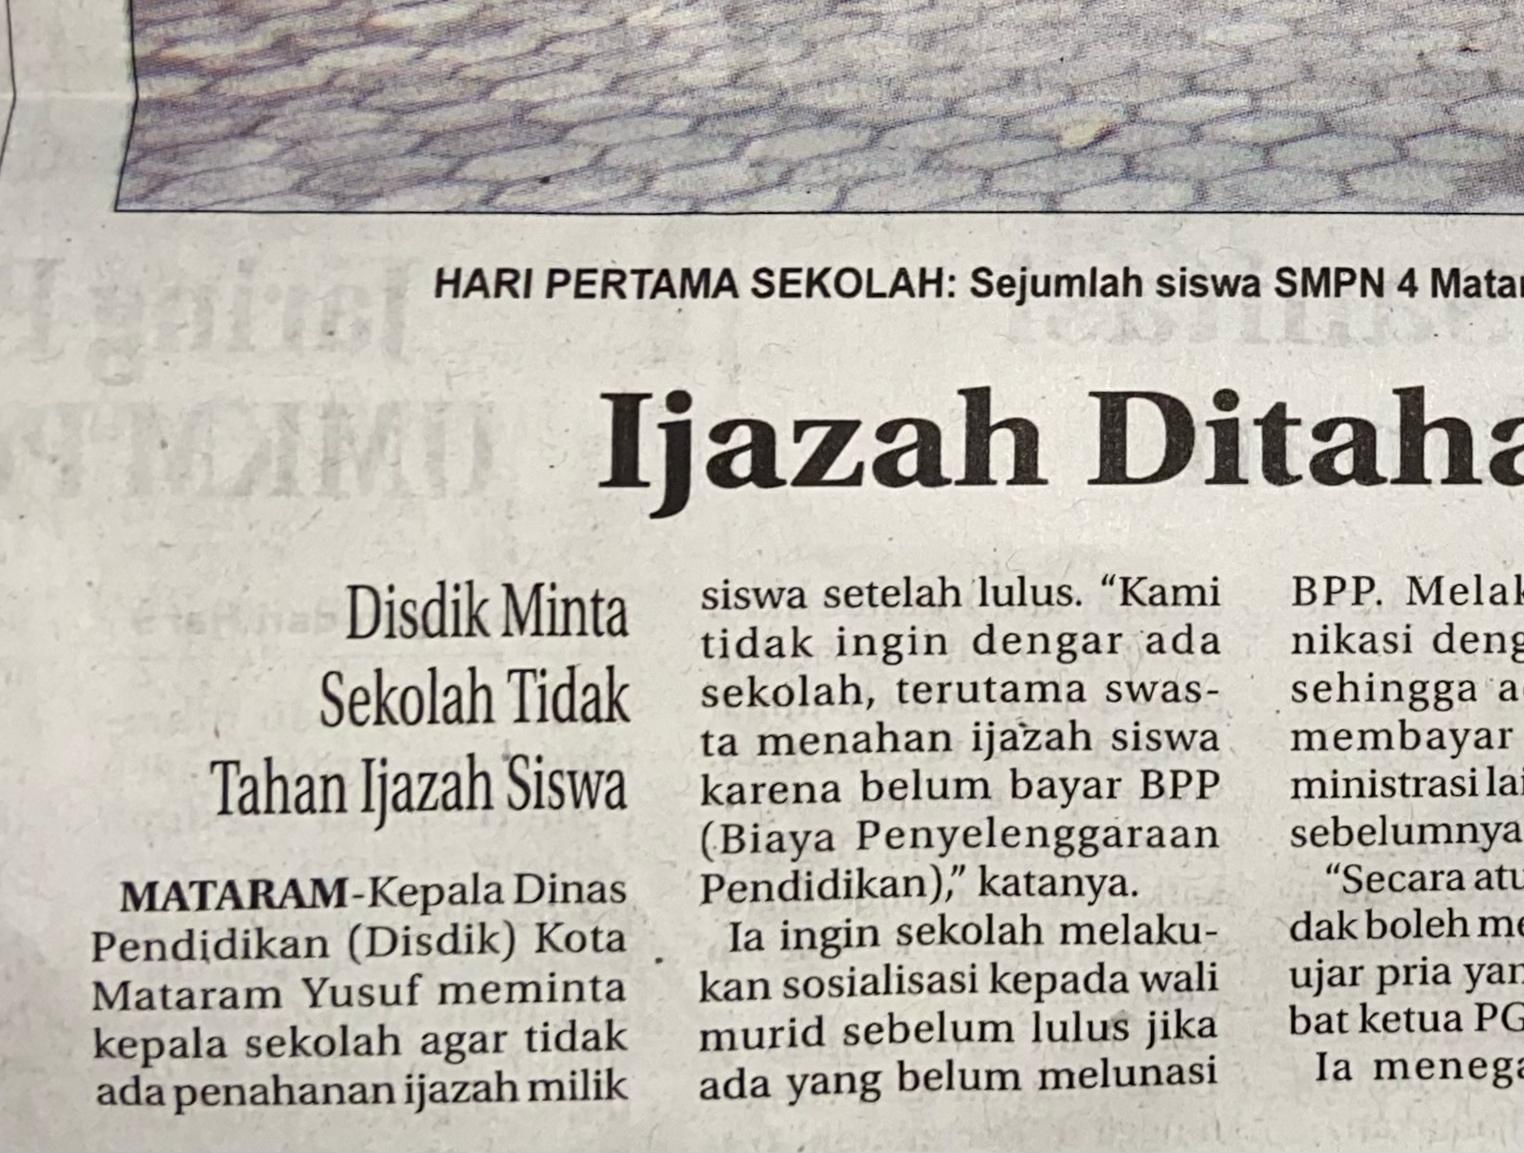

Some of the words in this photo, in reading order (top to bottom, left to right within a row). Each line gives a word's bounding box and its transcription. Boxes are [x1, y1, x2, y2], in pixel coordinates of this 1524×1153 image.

[434, 266, 534, 300] HARI
[545, 266, 740, 301] PERTAMA
[750, 266, 957, 300] SEKOLAH:
[969, 265, 1143, 307] Sejumlah
[1155, 265, 1262, 299] siswa
[1273, 265, 1385, 299] SMPN
[1396, 266, 1420, 299] 4
[597, 385, 1050, 520] Ijazah
[345, 578, 492, 640] Disdik
[500, 581, 630, 638] Minta
[1291, 575, 1383, 607] BPP.
[700, 625, 814, 660] tidak
[836, 624, 948, 666] ingin
[972, 622, 1124, 665] dengar
[1145, 622, 1222, 656] ada
[1290, 621, 1413, 655] nikasi
[320, 665, 497, 729] Sekolah
[506, 664, 632, 725] Tidak
[701, 672, 876, 711] sekolah,
[896, 676, 1087, 705] terutama
[1105, 680, 1220, 704] swas-
[1290, 718, 1514, 760] membayar
[209, 755, 349, 817] Tahan
[360, 751, 495, 832] Ijazah
[501, 753, 629, 812] Siswa
[700, 772, 842, 807] karena
[859, 767, 992, 803] belum
[1009, 766, 1123, 810] bayar
[1139, 768, 1221, 801] BPP
[513, 872, 627, 907] Dinas
[978, 863, 1139, 907] katanya.
[91, 926, 330, 965] Pendidikan
[348, 919, 516, 966] (Disdik)
[534, 921, 627, 954] Kota
[728, 920, 766, 953] Ia
[779, 917, 881, 960] ingin
[896, 912, 1045, 947] sekolah
[1059, 912, 1218, 946] melaku-
[92, 980, 283, 1012] Mataram
[301, 972, 424, 1009] Yusuf
[437, 971, 627, 1006] meminta
[698, 969, 773, 1004] kan
[782, 962, 979, 1000] sosialisasi
[988, 961, 1130, 1004] kepada
[1138, 959, 1220, 994] wali
[1288, 957, 1365, 998] ujar
[1375, 955, 1452, 996] pria
[1288, 1003, 1350, 1036] bat
[1358, 1001, 1464, 1034] ketua
[93, 1026, 228, 1069] kepala
[245, 1022, 402, 1059] sekolah
[420, 1030, 509, 1066] agar
[524, 1017, 629, 1054] tidak
[96, 1074, 166, 1107] ada
[173, 1073, 396, 1116] penahanan
[404, 1069, 520, 1115] ijazah
[527, 1066, 629, 1103] milik
[699, 1066, 772, 1101] ada
[785, 1070, 883, 1107] yang
[896, 1058, 1022, 1092] belum
[1037, 1054, 1219, 1091] melunasi
